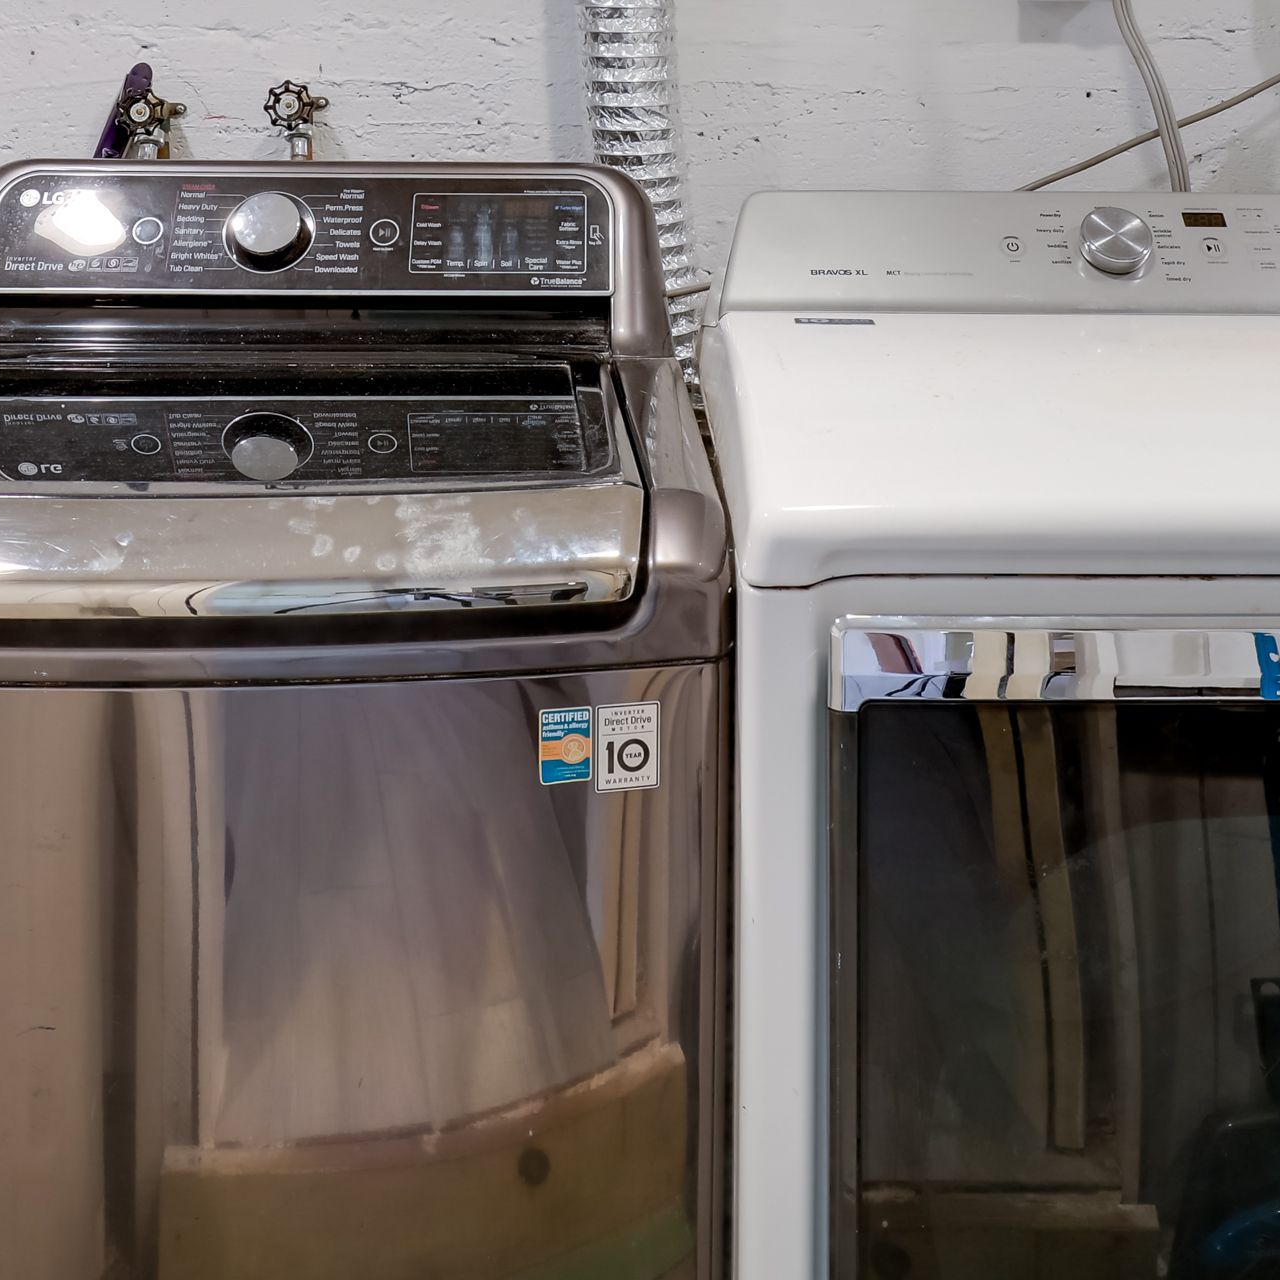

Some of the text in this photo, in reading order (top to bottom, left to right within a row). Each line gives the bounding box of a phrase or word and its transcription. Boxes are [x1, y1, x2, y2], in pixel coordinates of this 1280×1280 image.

[42, 192, 65, 205] LG
[174, 227, 204, 235] Sanitary
[171, 252, 192, 260] Bright
[316, 253, 338, 261] Speed
[4, 261, 64, 271] Direct Drive
[542, 711, 589, 724] CERTIFIED
[604, 716, 652, 727] Direct Drive
[605, 738, 650, 775] 10
[605, 776, 651, 785] WARRANTY
